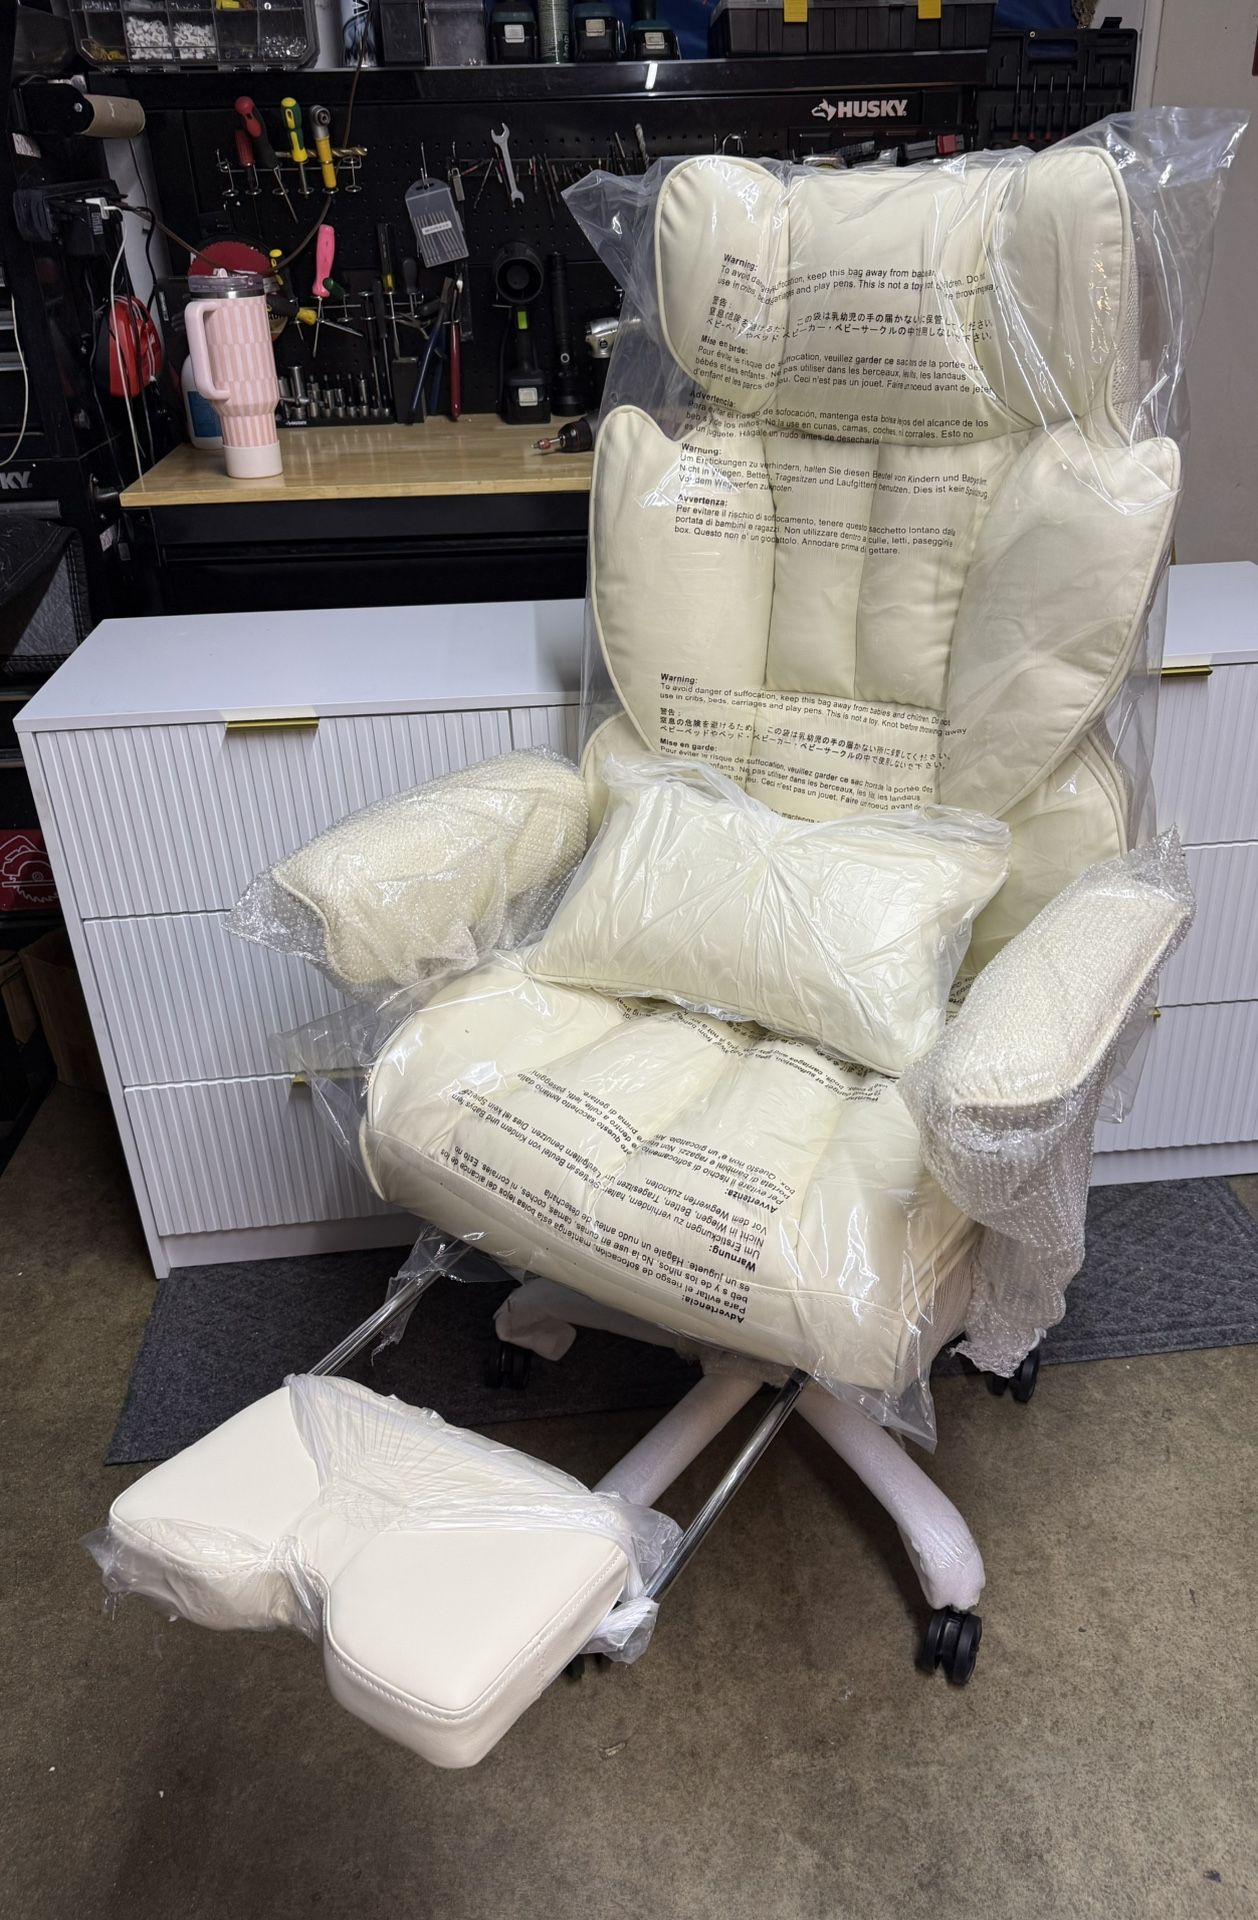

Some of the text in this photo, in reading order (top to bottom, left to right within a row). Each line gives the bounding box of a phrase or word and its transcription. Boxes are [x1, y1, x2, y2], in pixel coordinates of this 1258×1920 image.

[838, 100, 907, 118] HUSKY
[807, 270, 827, 281] keep
[829, 267, 845, 275] this
[848, 267, 863, 278] bag
[866, 269, 886, 278] away
[890, 269, 909, 277] from
[796, 286, 811, 294] and
[814, 281, 830, 293] play
[833, 277, 855, 288] pens.
[859, 280, 875, 289] This
[888, 281, 900, 289] not
[824, 353, 853, 362] veuillez
[855, 356, 882, 365] garder
[800, 363, 824, 373] utiliser
[827, 365, 846, 374] dans
[863, 368, 900, 378] berceaux,
[813, 376, 884, 388] n'est pas jouet.
[819, 411, 859, 421] mantenga
[927, 418, 960, 427] alcance
[905, 429, 938, 439] corrales.
[941, 430, 961, 438] Esto
[681, 443, 722, 455] Warnung:
[829, 467, 841, 475] Sie
[844, 468, 870, 478] diesen
[907, 475, 940, 483] Kindern
[943, 474, 959, 482] und
[775, 473, 946, 494] Tragesitzen Dies ist
[678, 494, 728, 507] Avvertenza:
[675, 517, 703, 527] portata
[715, 519, 746, 530] bambini
[784, 526, 801, 534] Non
[803, 528, 837, 538] utilizzare
[676, 505, 940, 535] Per evitare tenere sacchetto lontano
[675, 526, 839, 548] box. Questo non Annodare
[660, 673, 698, 684] Warning:
[673, 684, 692, 693] avoid
[695, 687, 721, 695] danger
[734, 690, 777, 701] suffocation,
[781, 695, 799, 704] keep
[802, 695, 815, 704] this
[818, 698, 831, 707] bag
[833, 702, 851, 711] away
[853, 704, 868, 712] from
[870, 707, 891, 717] babies
[893, 711, 905, 719] and
[731, 699, 766, 708] carriages
[786, 704, 801, 714] play
[804, 706, 822, 715] pens.
[827, 709, 841, 718] This
[851, 714, 861, 722] not
[882, 719, 898, 728] Knot
[945, 728, 966, 736] away
[660, 738, 678, 747] Mise
[692, 743, 717, 752] garde:
[710, 753, 838, 781] risque garder
[768, 770, 788, 780] utiliser
[790, 775, 805, 784] dans
[808, 778, 817, 787] les
[761, 777, 858, 804] Ceci pas jouet. Faire
[562, 1099, 596, 1123] sacchetto
[514, 1115, 529, 1130] Dies
[500, 1123, 527, 1142] Kindern
[531, 1126, 565, 1151] benutzen.
[596, 1121, 621, 1143] questo
[463, 1151, 479, 1167] Esto
[541, 1147, 566, 1166] Beutel
[459, 1163, 486, 1184] alcance
[481, 1162, 510, 1185] corrales.
[702, 1168, 730, 1183] rischio
[746, 1164, 776, 1180] Questo
[486, 1180, 498, 1191] del
[716, 1162, 790, 1200] portata bambini
[499, 1187, 515, 1203] lejos
[520, 1185, 547, 1208] coches,
[616, 1179, 659, 1203] Tragesitzen
[517, 1199, 536, 1216] bolsa
[628, 1195, 671, 1221] verhindern,
[645, 1177, 767, 1235] Vor dem Wegwerfen zuknoten.
[664, 1198, 691, 1216] Betten,
[724, 1188, 778, 1213] Avvertenza:
[537, 1212, 552, 1226] esta
[548, 1204, 572, 1224] camas,
[673, 1216, 684, 1225] zu
[695, 1211, 727, 1233] Wiegen,
[554, 1222, 591, 1247] mantenga
[618, 1231, 639, 1244] nudo
[685, 1221, 740, 1252] Erstickungen
[730, 1227, 738, 1237] in
[740, 1231, 764, 1247] Nicht
[614, 1242, 629, 1254] use
[744, 1247, 760, 1260] Um
[641, 1254, 653, 1265] No
[654, 1247, 684, 1266] Hágale
[708, 1244, 756, 1272] Warnung:
[642, 1267, 653, 1276] de
[657, 1261, 682, 1277] niños.
[687, 1261, 724, 1282] juguete.
[655, 1272, 682, 1288] riesgo
[685, 1273, 698, 1284] los
[701, 1279, 711, 1289] de
[685, 1285, 693, 1293] el
[695, 1290, 721, 1303] evitar
[730, 1291, 748, 1303] beb
[681, 1295, 744, 1323] Advertencia:
[724, 1300, 746, 1314] Para
